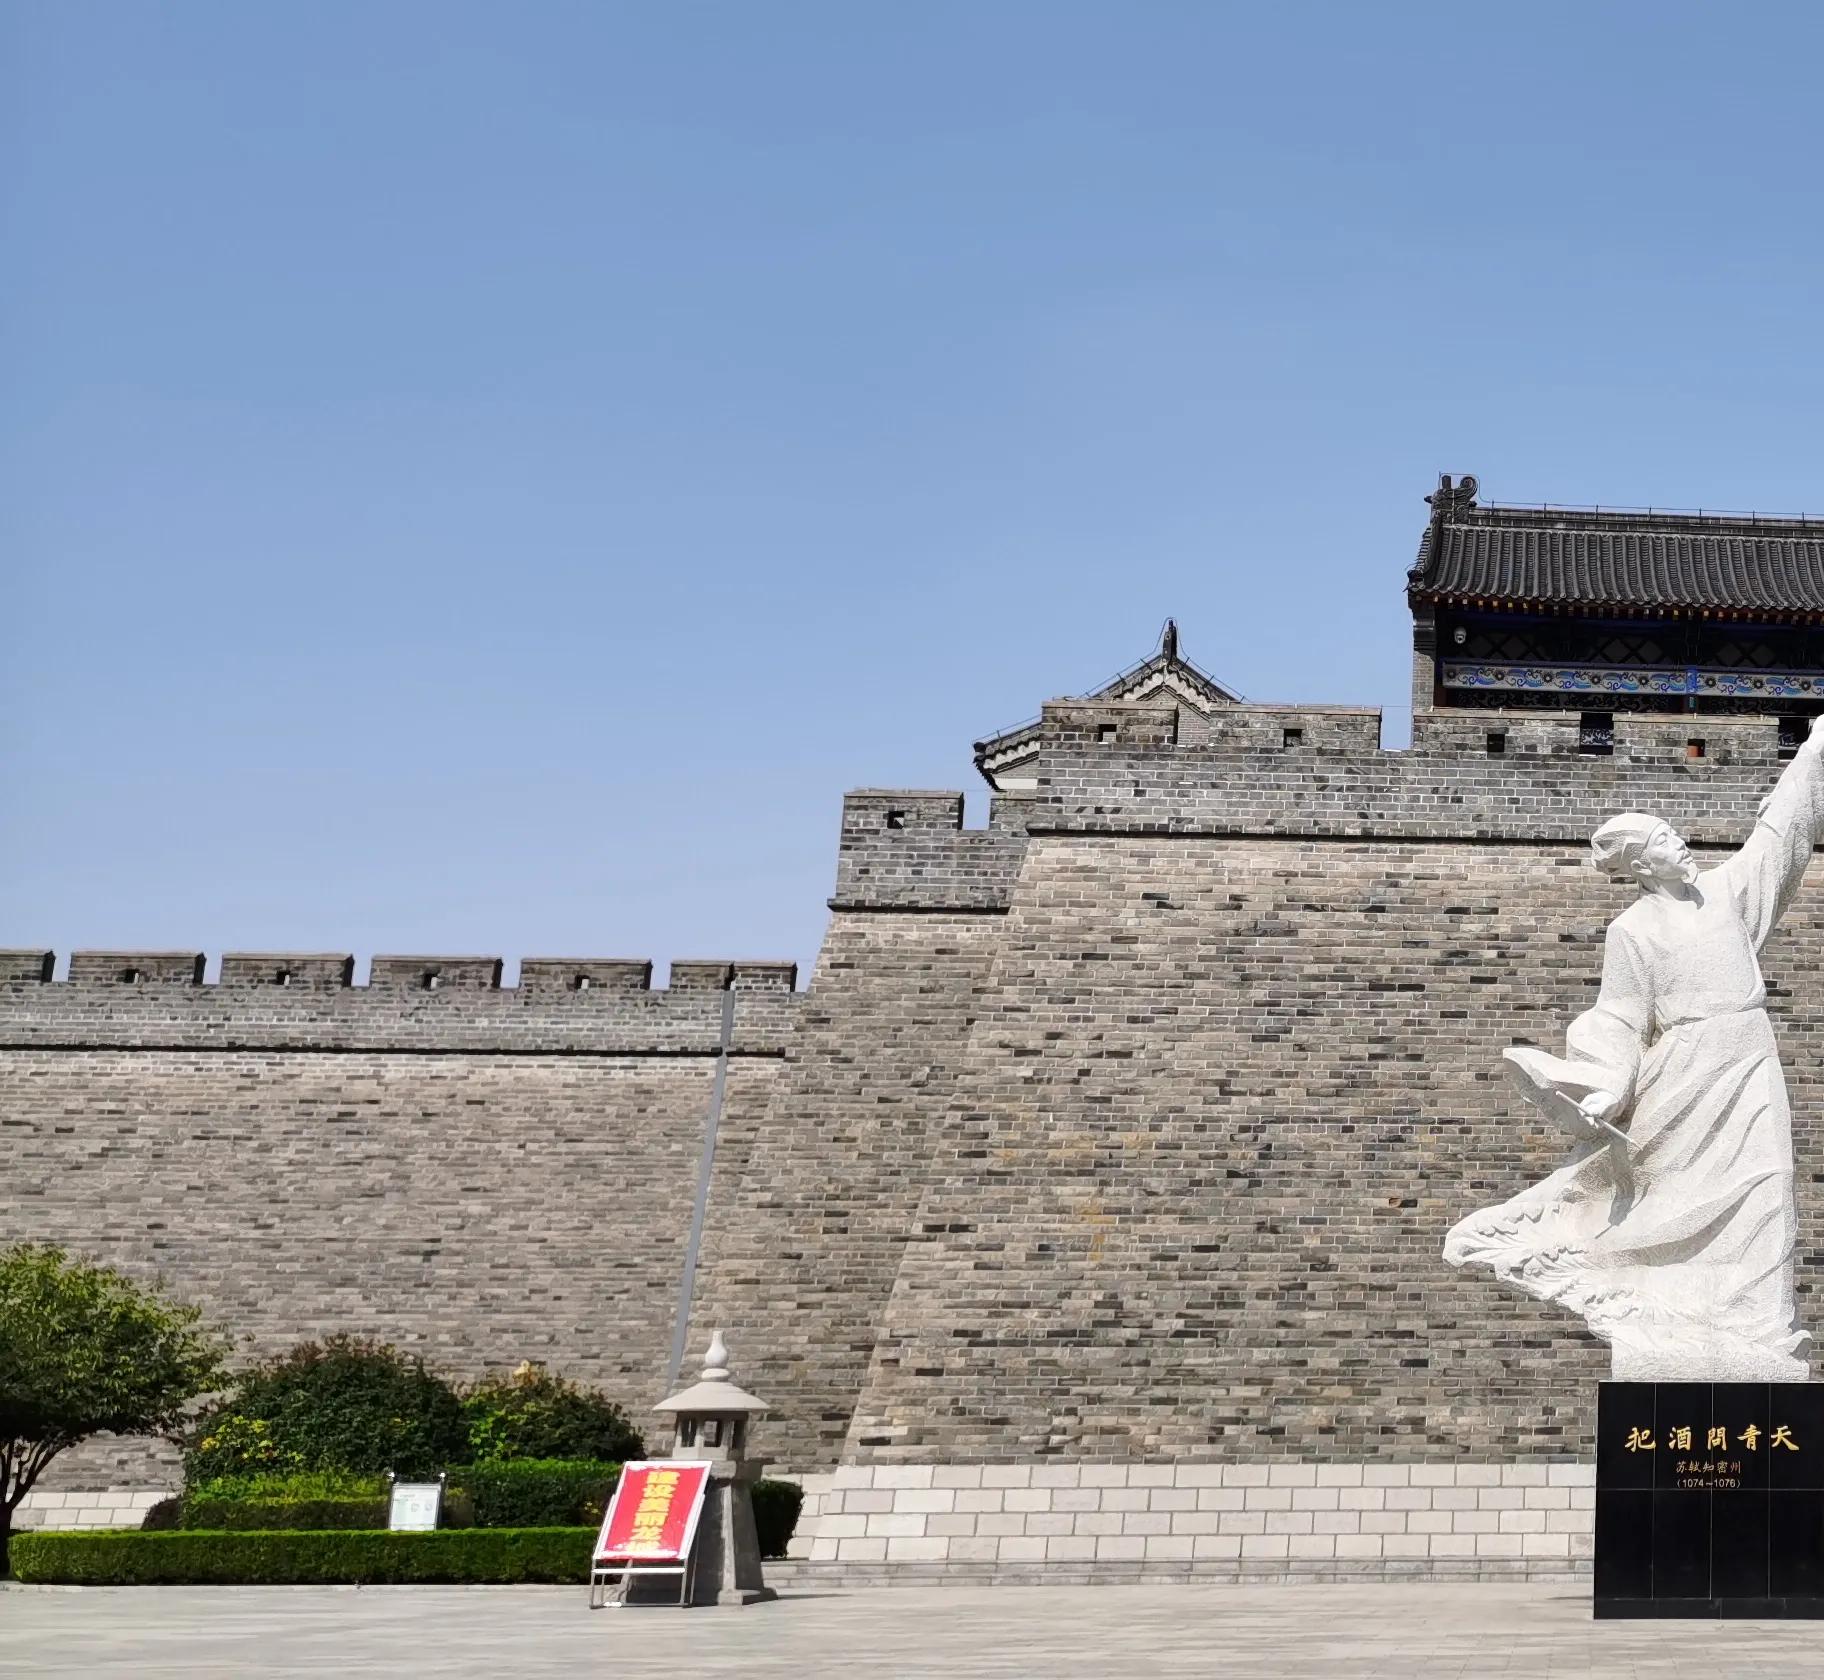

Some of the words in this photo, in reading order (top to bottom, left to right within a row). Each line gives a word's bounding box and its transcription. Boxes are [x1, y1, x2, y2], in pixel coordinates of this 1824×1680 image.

[1676, 1460, 1741, 1474] 苏轼知密州
